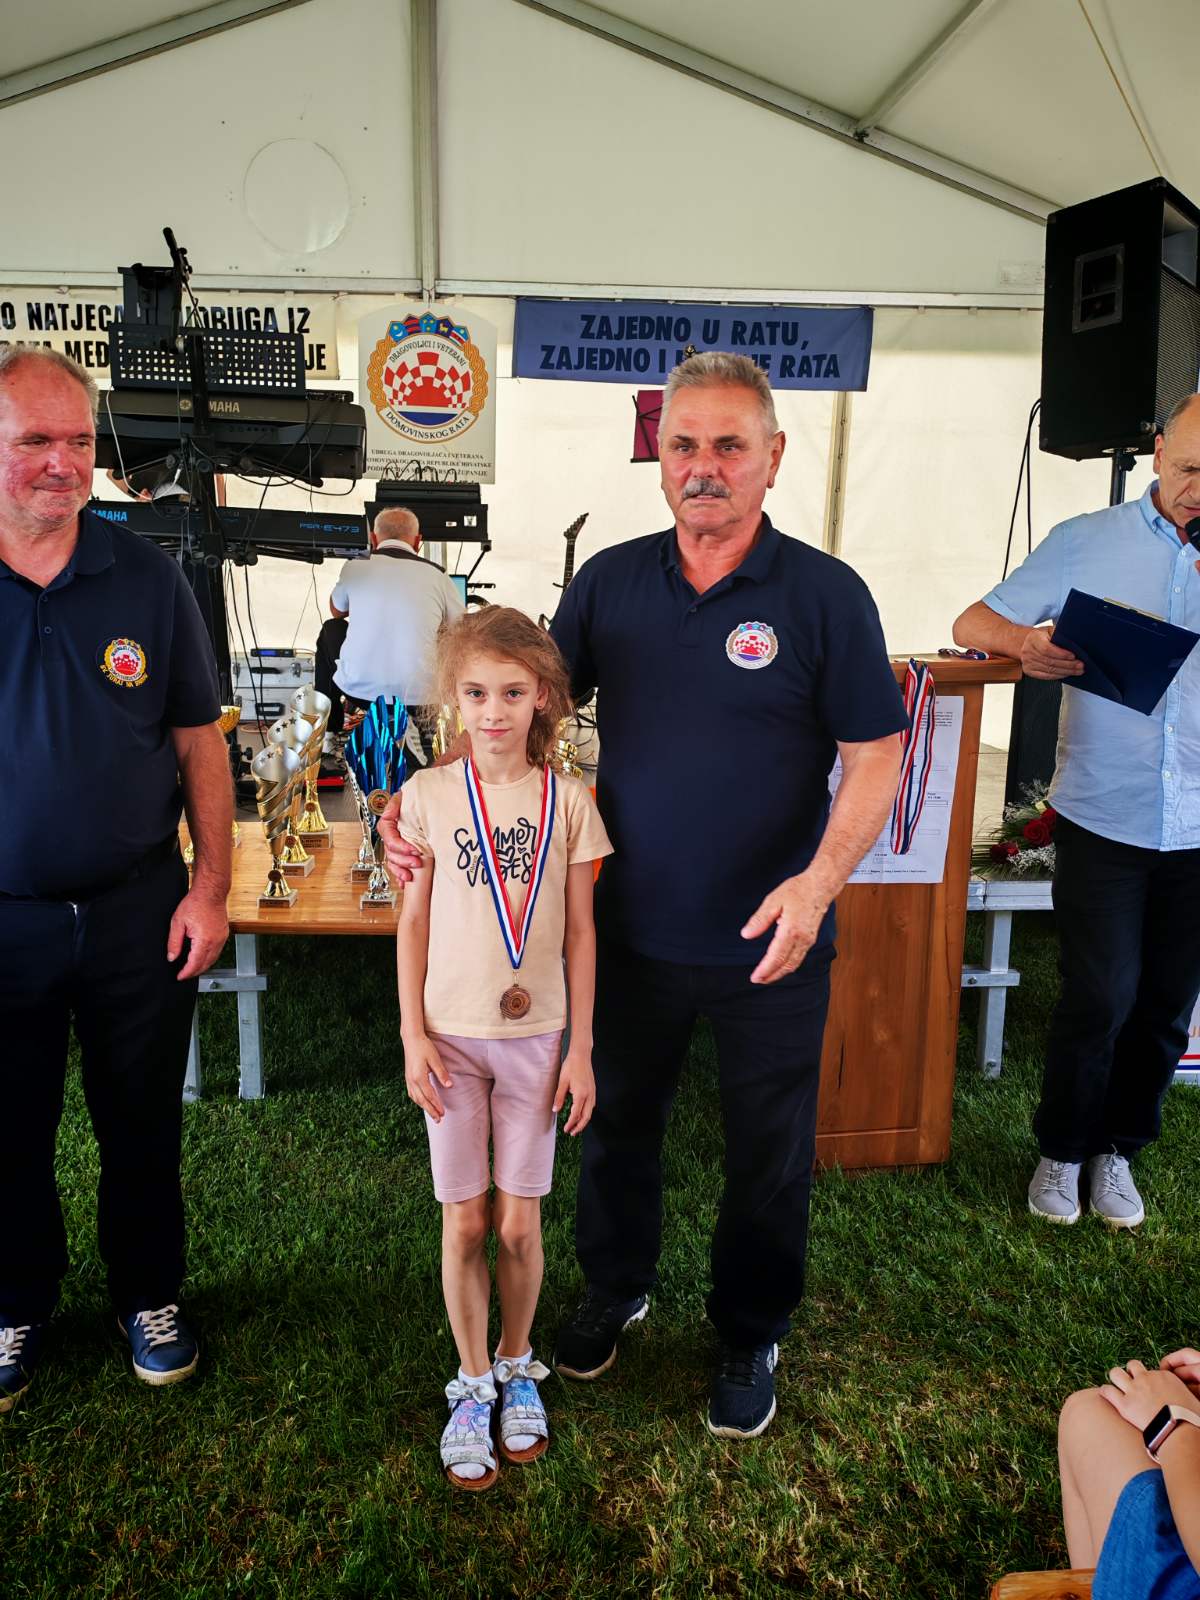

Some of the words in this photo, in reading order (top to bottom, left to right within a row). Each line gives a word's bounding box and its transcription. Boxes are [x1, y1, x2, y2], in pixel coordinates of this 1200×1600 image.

[0, 302, 16, 330] O
[26, 302, 124, 332] NATJECA
[288, 307, 311, 334] IZ
[580, 314, 692, 343] ZAJEDNO
[702, 319, 720, 345] U
[731, 320, 809, 350] RATU,
[436, 342, 467, 367] VETERANI
[540, 345, 651, 373] ZAJEDNO
[659, 349, 666, 374] I
[780, 354, 841, 379] RATA
[208, 400, 241, 413] MAHA
[385, 411, 449, 439] DOMOVINSKOG
[449, 416, 470, 434] RATA
[91, 509, 128, 522] MAHA
